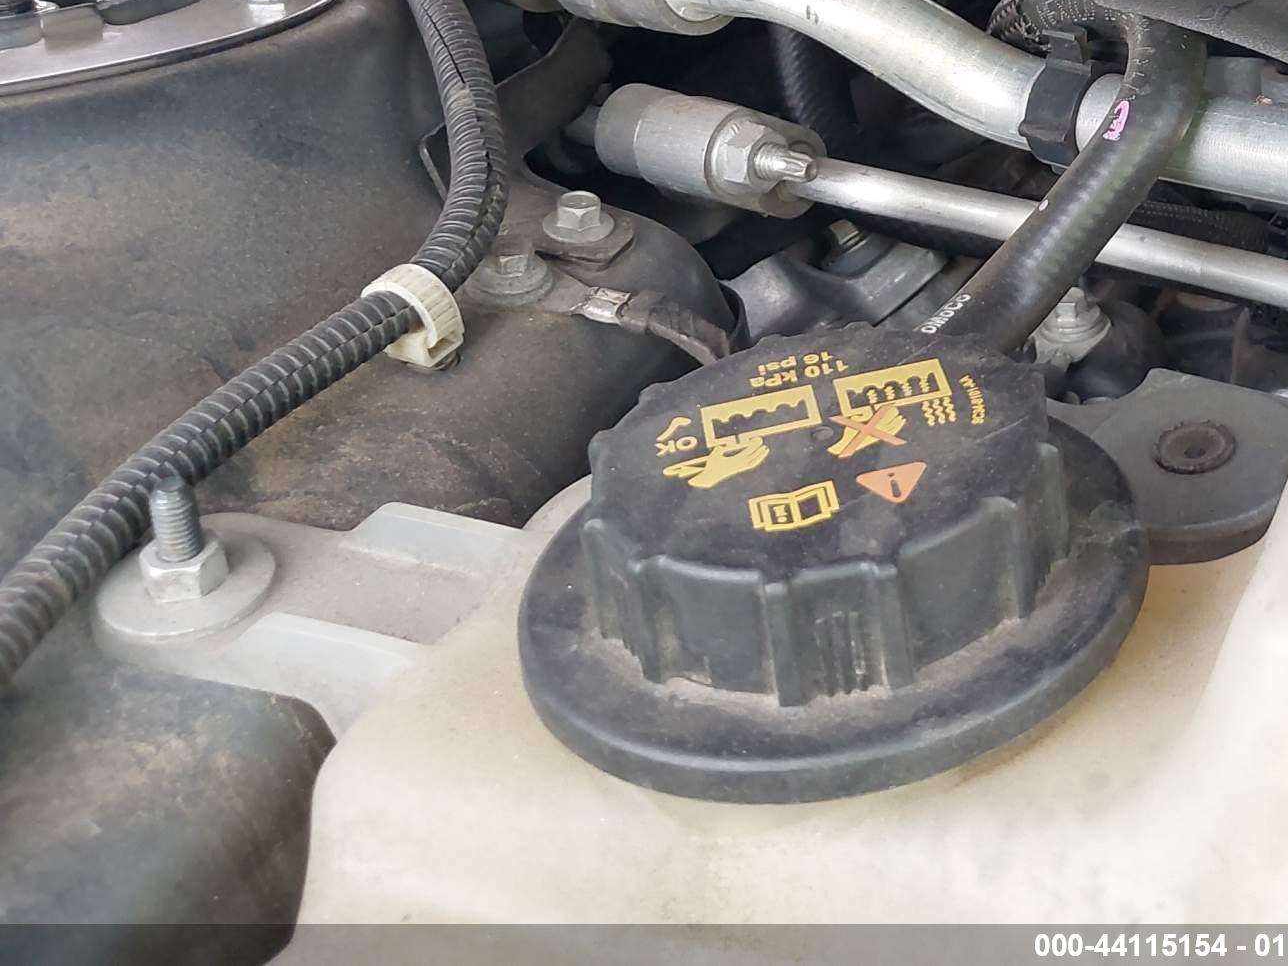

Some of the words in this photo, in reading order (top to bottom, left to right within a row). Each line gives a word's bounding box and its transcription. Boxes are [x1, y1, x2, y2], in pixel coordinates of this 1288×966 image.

[758, 354, 798, 376] psi
[803, 351, 834, 365] 16
[749, 369, 798, 388] kPa
[803, 359, 849, 379] 110
[655, 437, 698, 458] OK
